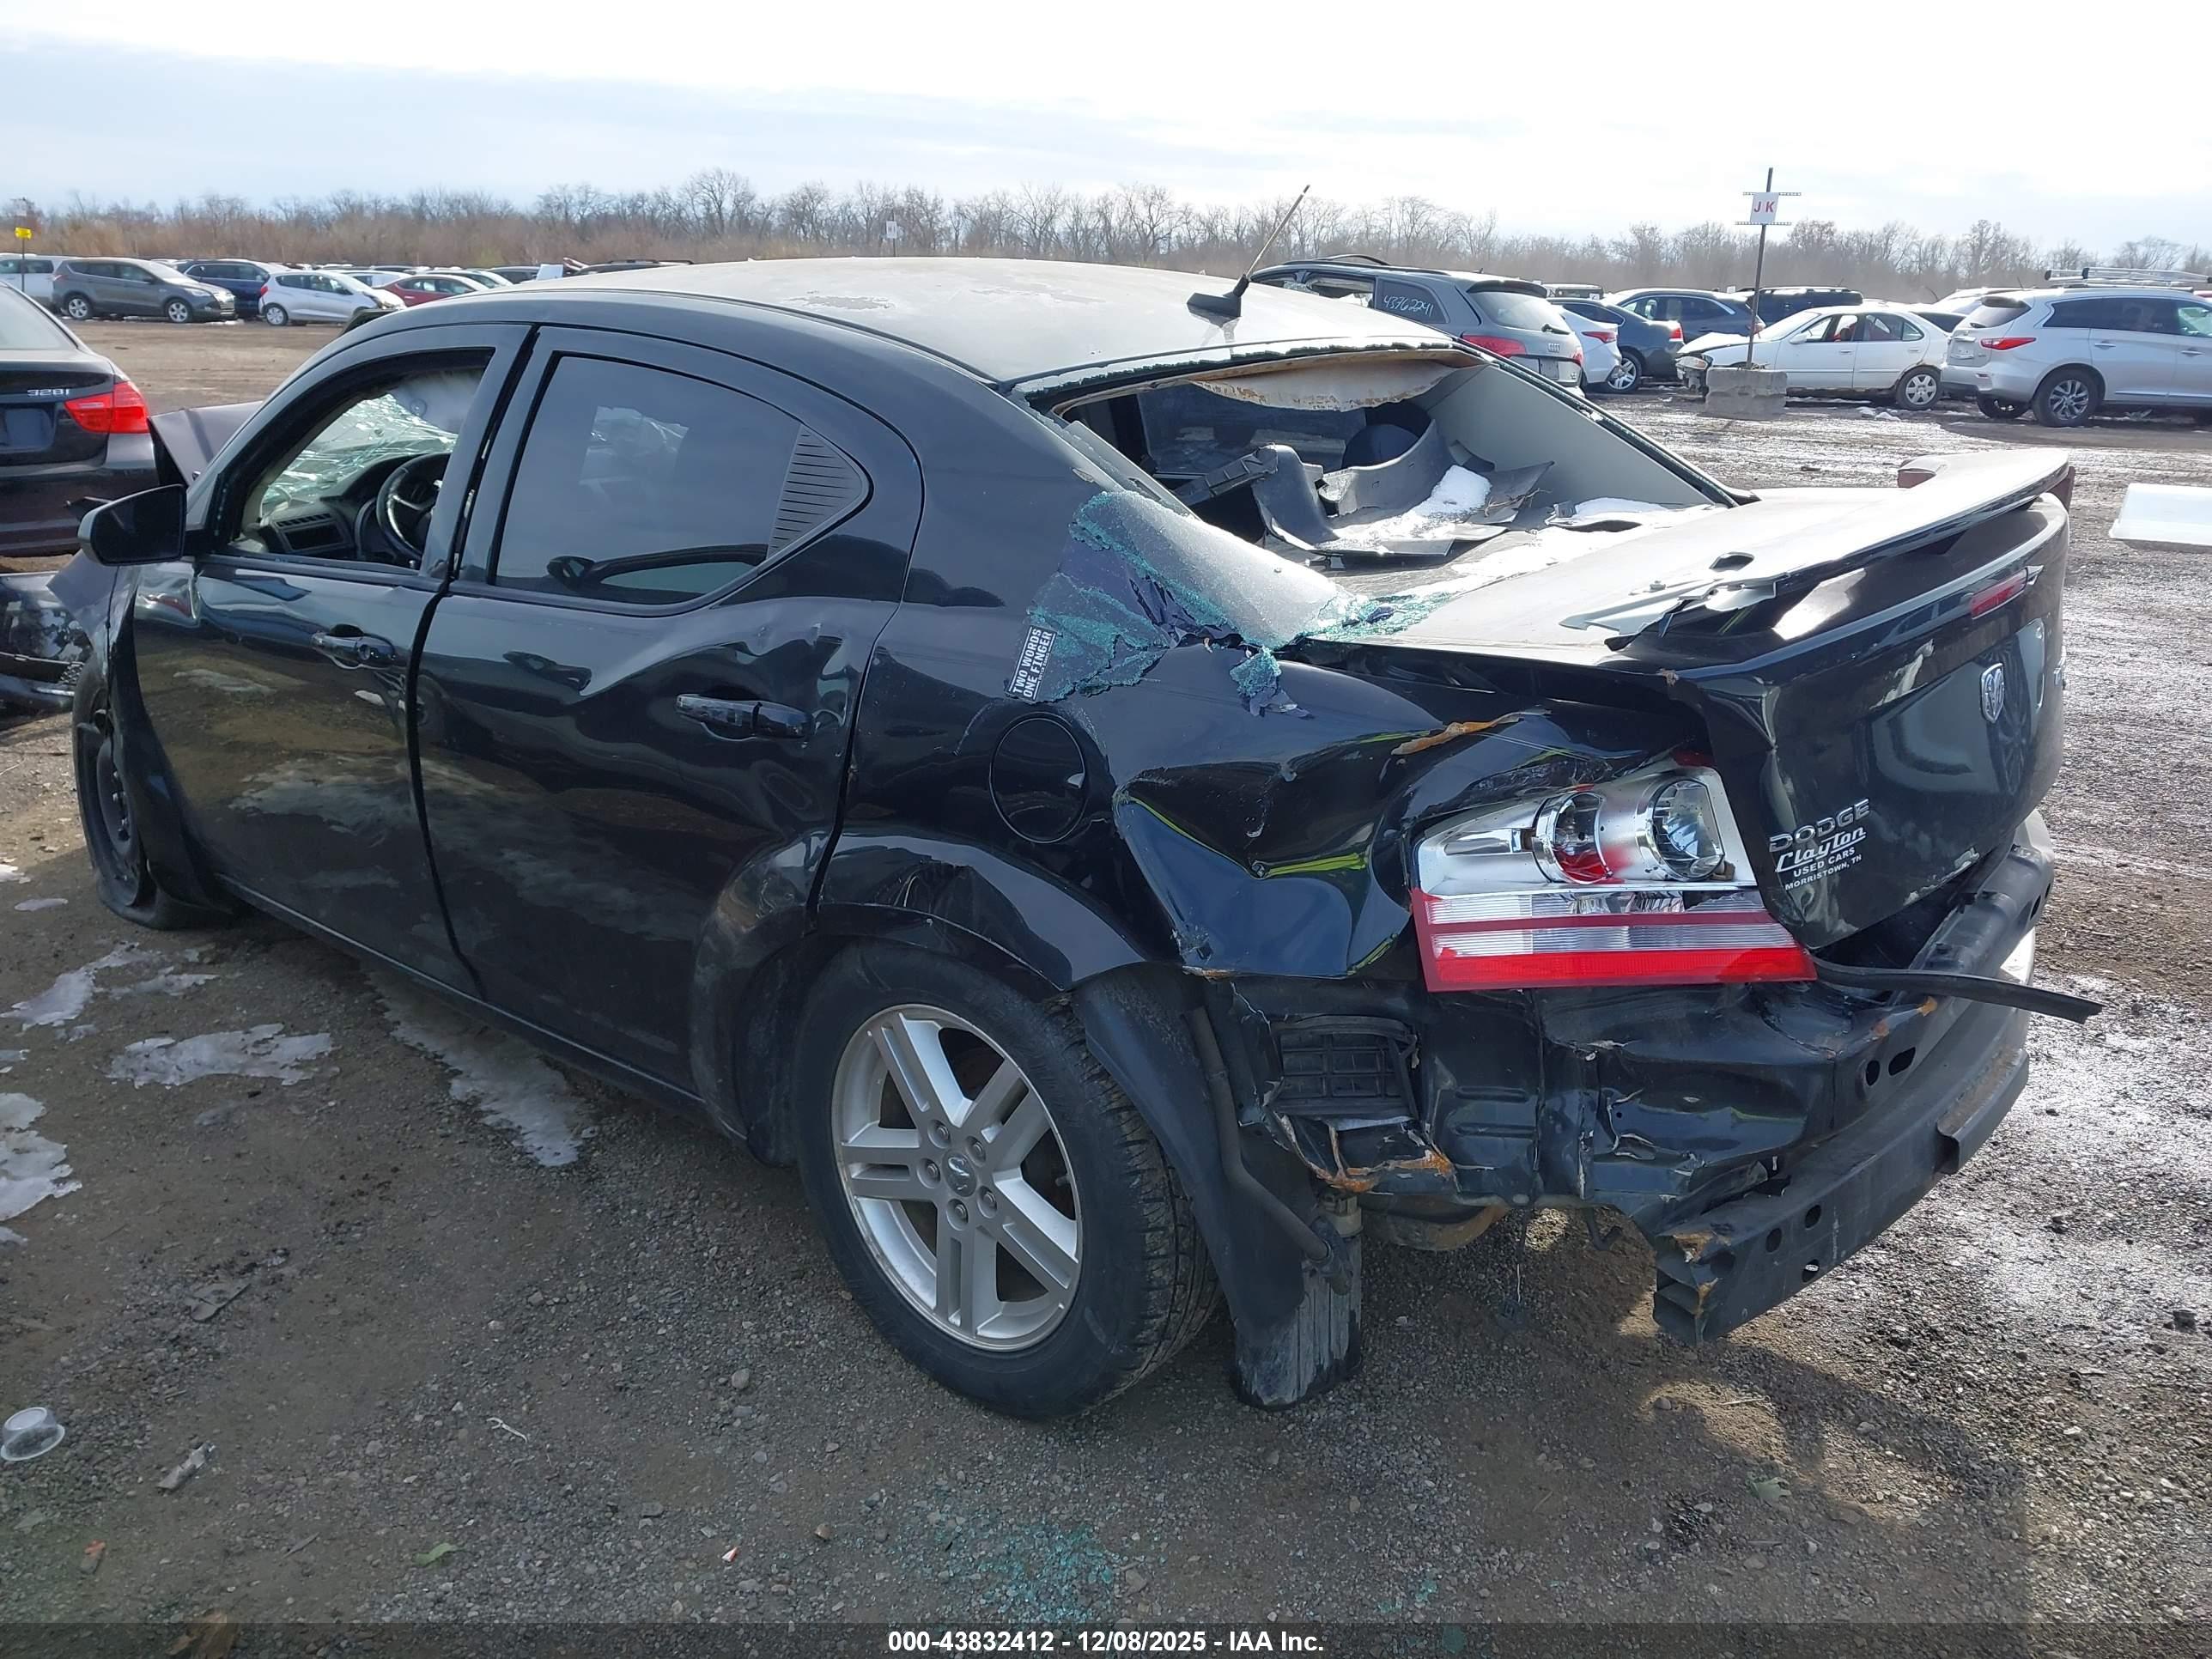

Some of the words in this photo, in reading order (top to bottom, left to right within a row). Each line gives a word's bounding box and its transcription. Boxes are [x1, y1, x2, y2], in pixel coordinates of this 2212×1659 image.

[1753, 200, 1762, 213] J
[1765, 200, 1775, 213] K
[1383, 295, 1434, 317] 43762241
[1012, 670, 1028, 693] TWO
[1021, 629, 1042, 667] WORDS
[1030, 631, 1053, 674] FINGER
[1023, 675, 1038, 698] ONE
[1769, 799, 1870, 853] DODGE
[1775, 827, 1867, 872] Clayton
[1793, 860, 1825, 878] USED
[1828, 847, 1855, 865] CARS
[1785, 861, 1850, 890] MORRISTOWN,
[1850, 854, 1862, 865] TN
